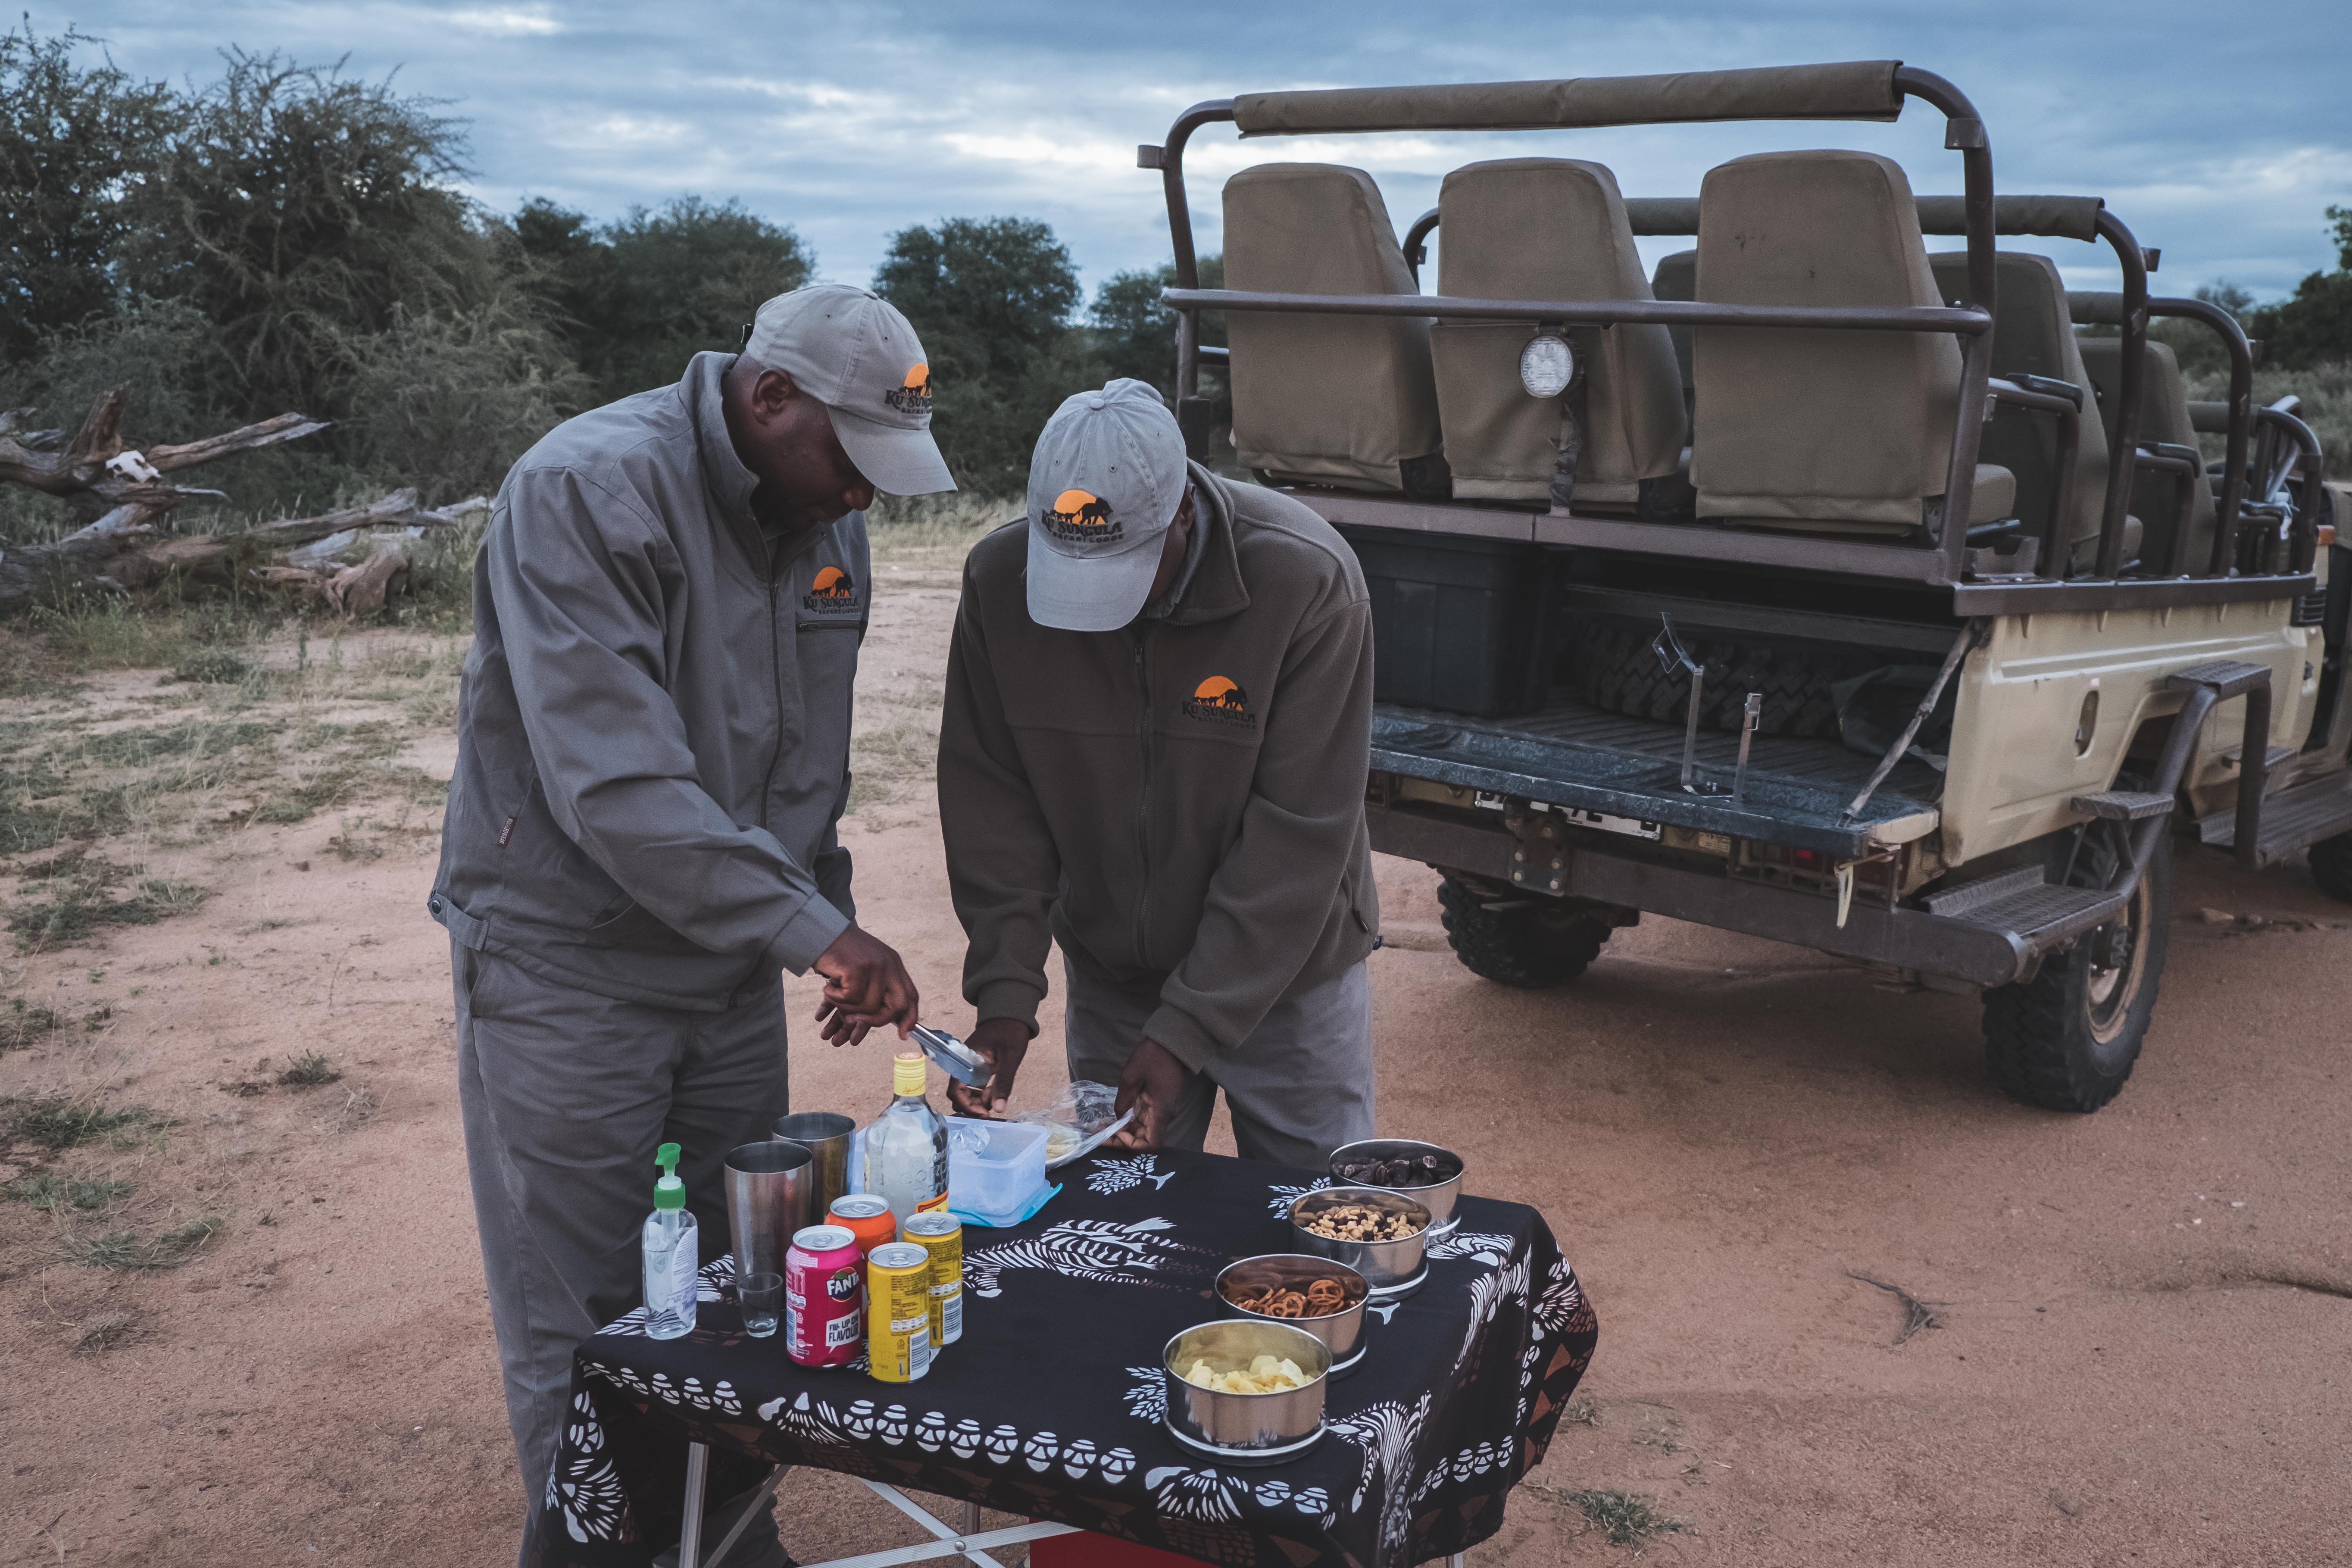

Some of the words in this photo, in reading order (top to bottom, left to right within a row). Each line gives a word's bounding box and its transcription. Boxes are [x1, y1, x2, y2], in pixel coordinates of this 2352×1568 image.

[1058, 521, 1123, 537] SUNGULA
[803, 596, 818, 612] KU
[1182, 701, 1198, 719] KU
[1203, 705, 1256, 723] SUNGULA
[842, 1319, 850, 1328] UP
[829, 1323, 859, 1342] FLAVOUR
